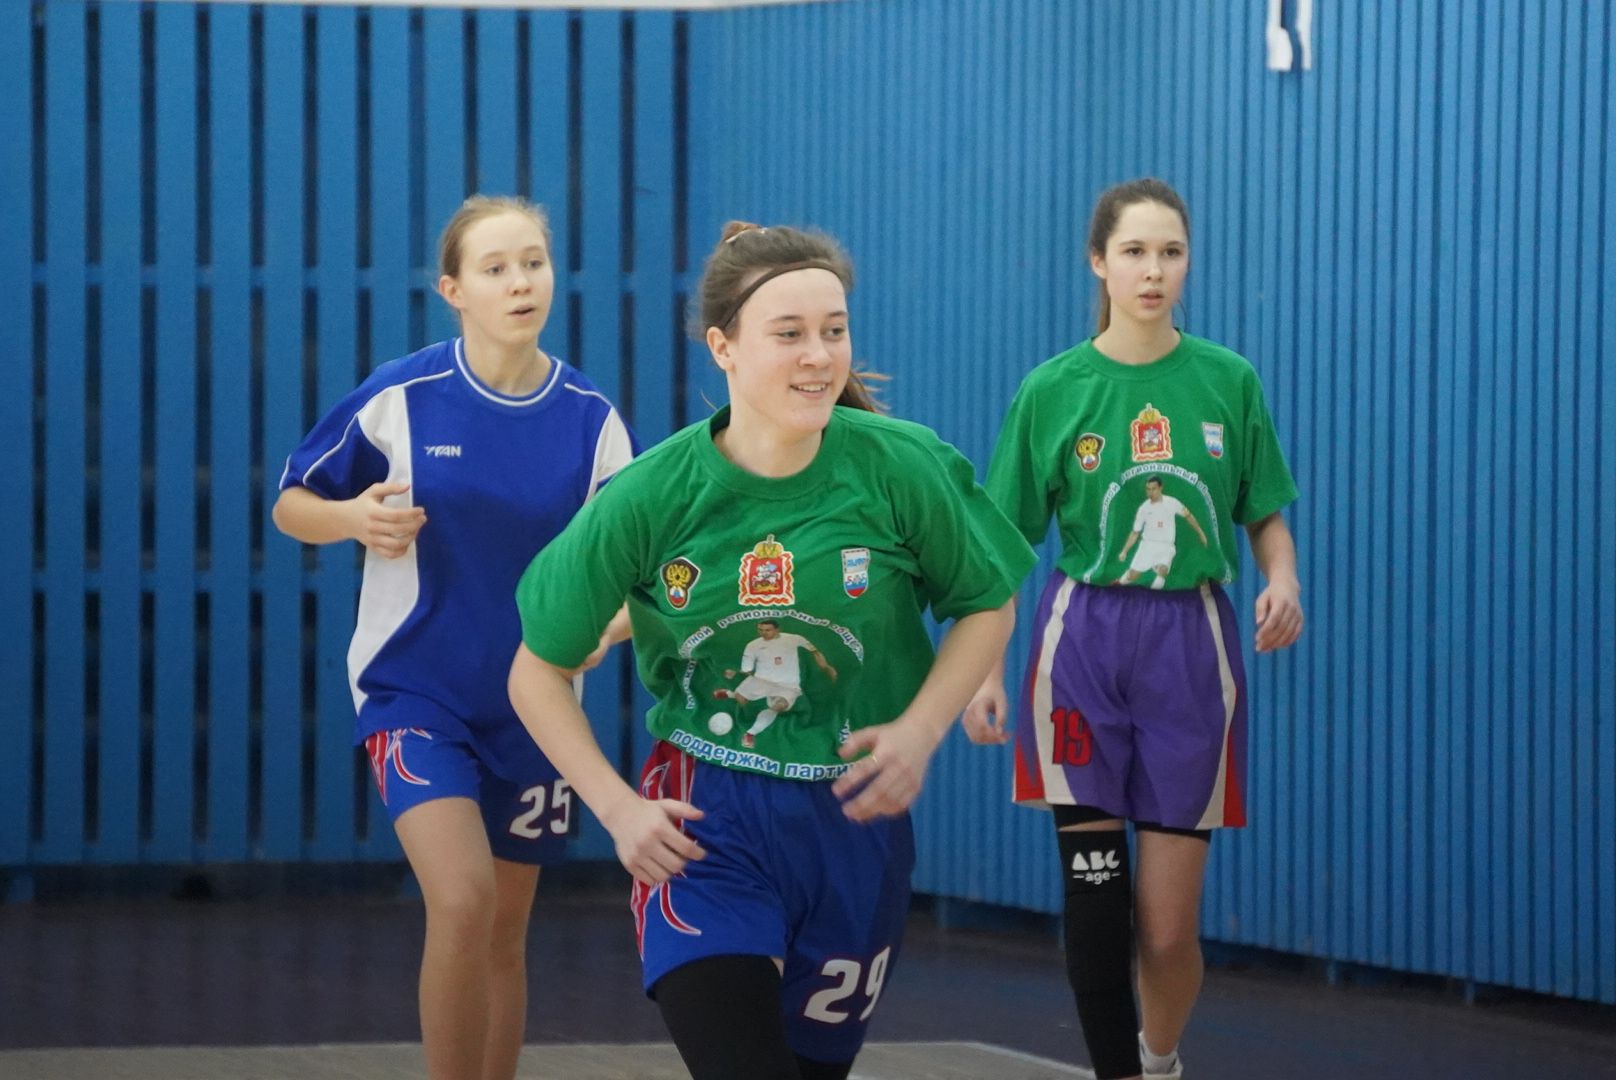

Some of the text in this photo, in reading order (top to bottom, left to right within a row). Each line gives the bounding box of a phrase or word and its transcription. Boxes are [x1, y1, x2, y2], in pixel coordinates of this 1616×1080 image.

[668, 728, 854, 781] поддержки парти
[1050, 706, 1093, 767] 19
[509, 779, 570, 839] 25
[1072, 850, 1120, 871] ABC
[803, 946, 890, 1024] 29
